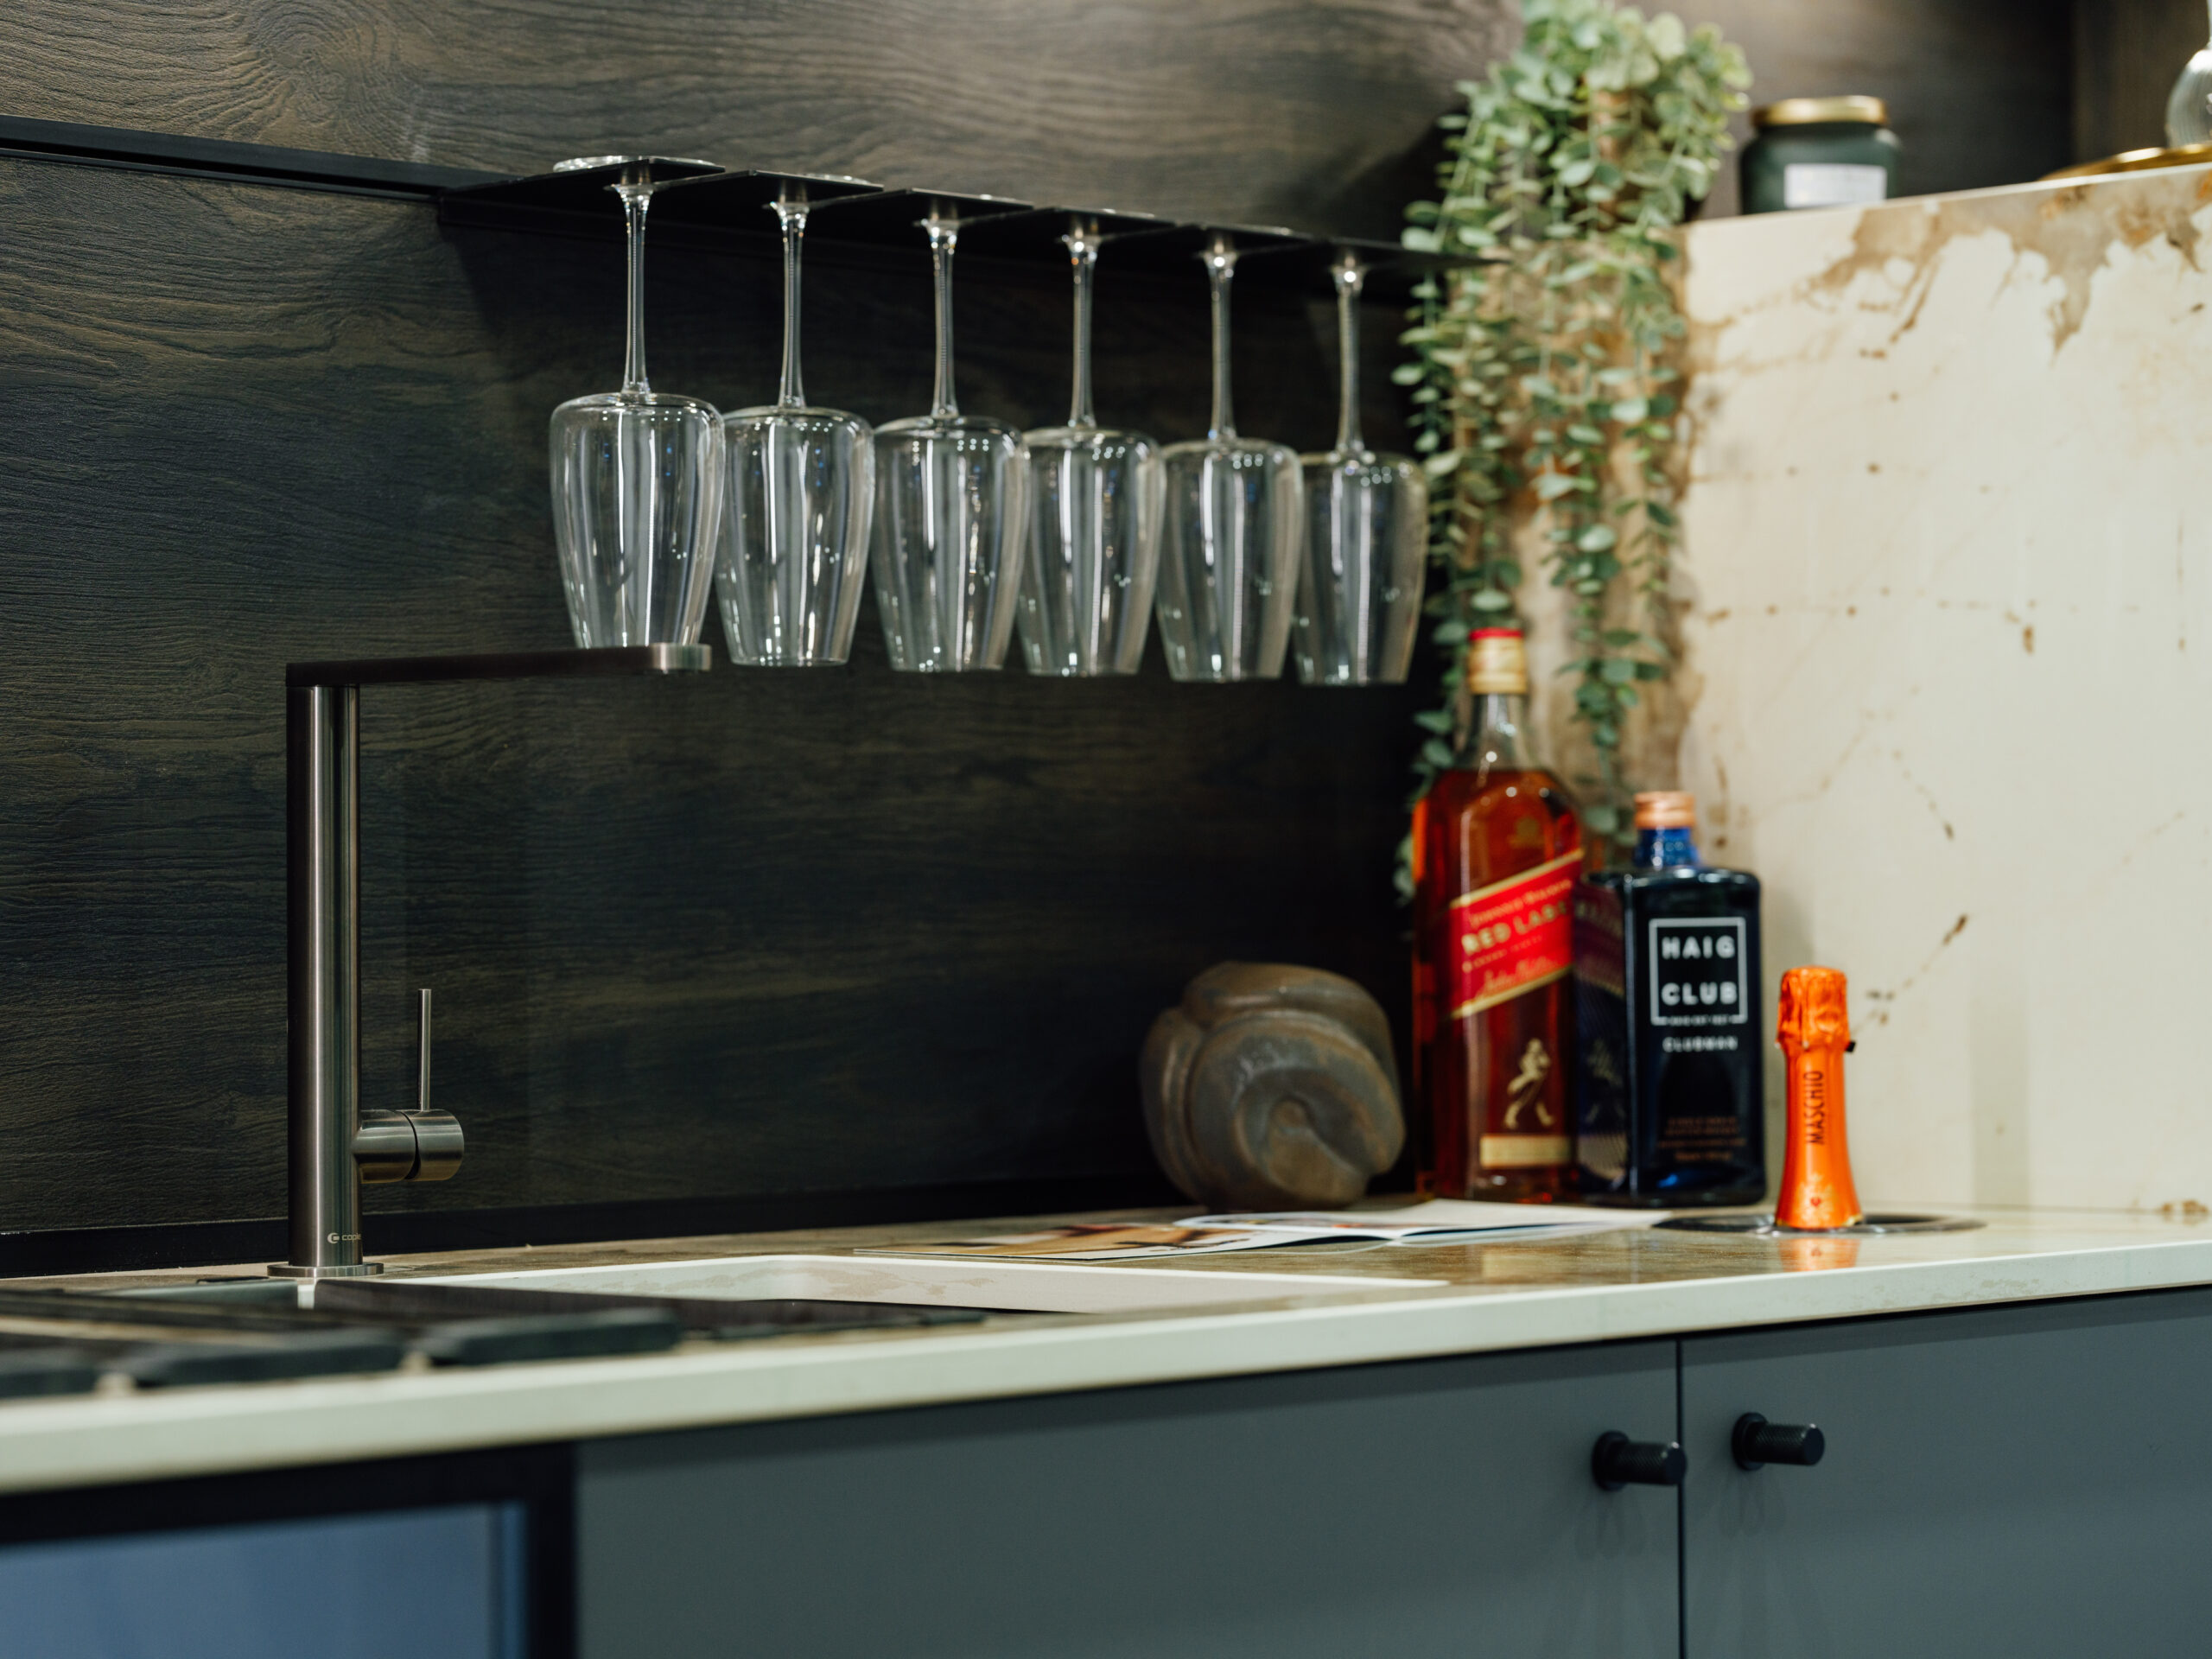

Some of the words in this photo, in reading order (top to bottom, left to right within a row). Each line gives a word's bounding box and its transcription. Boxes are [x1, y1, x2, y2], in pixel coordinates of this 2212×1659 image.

[1461, 922, 1511, 955] RED
[1513, 900, 1567, 935] LABE
[1662, 935, 1736, 960] HAIG
[1661, 981, 1738, 1006] CLUB
[1803, 1071, 1825, 1146] MASCHIO
